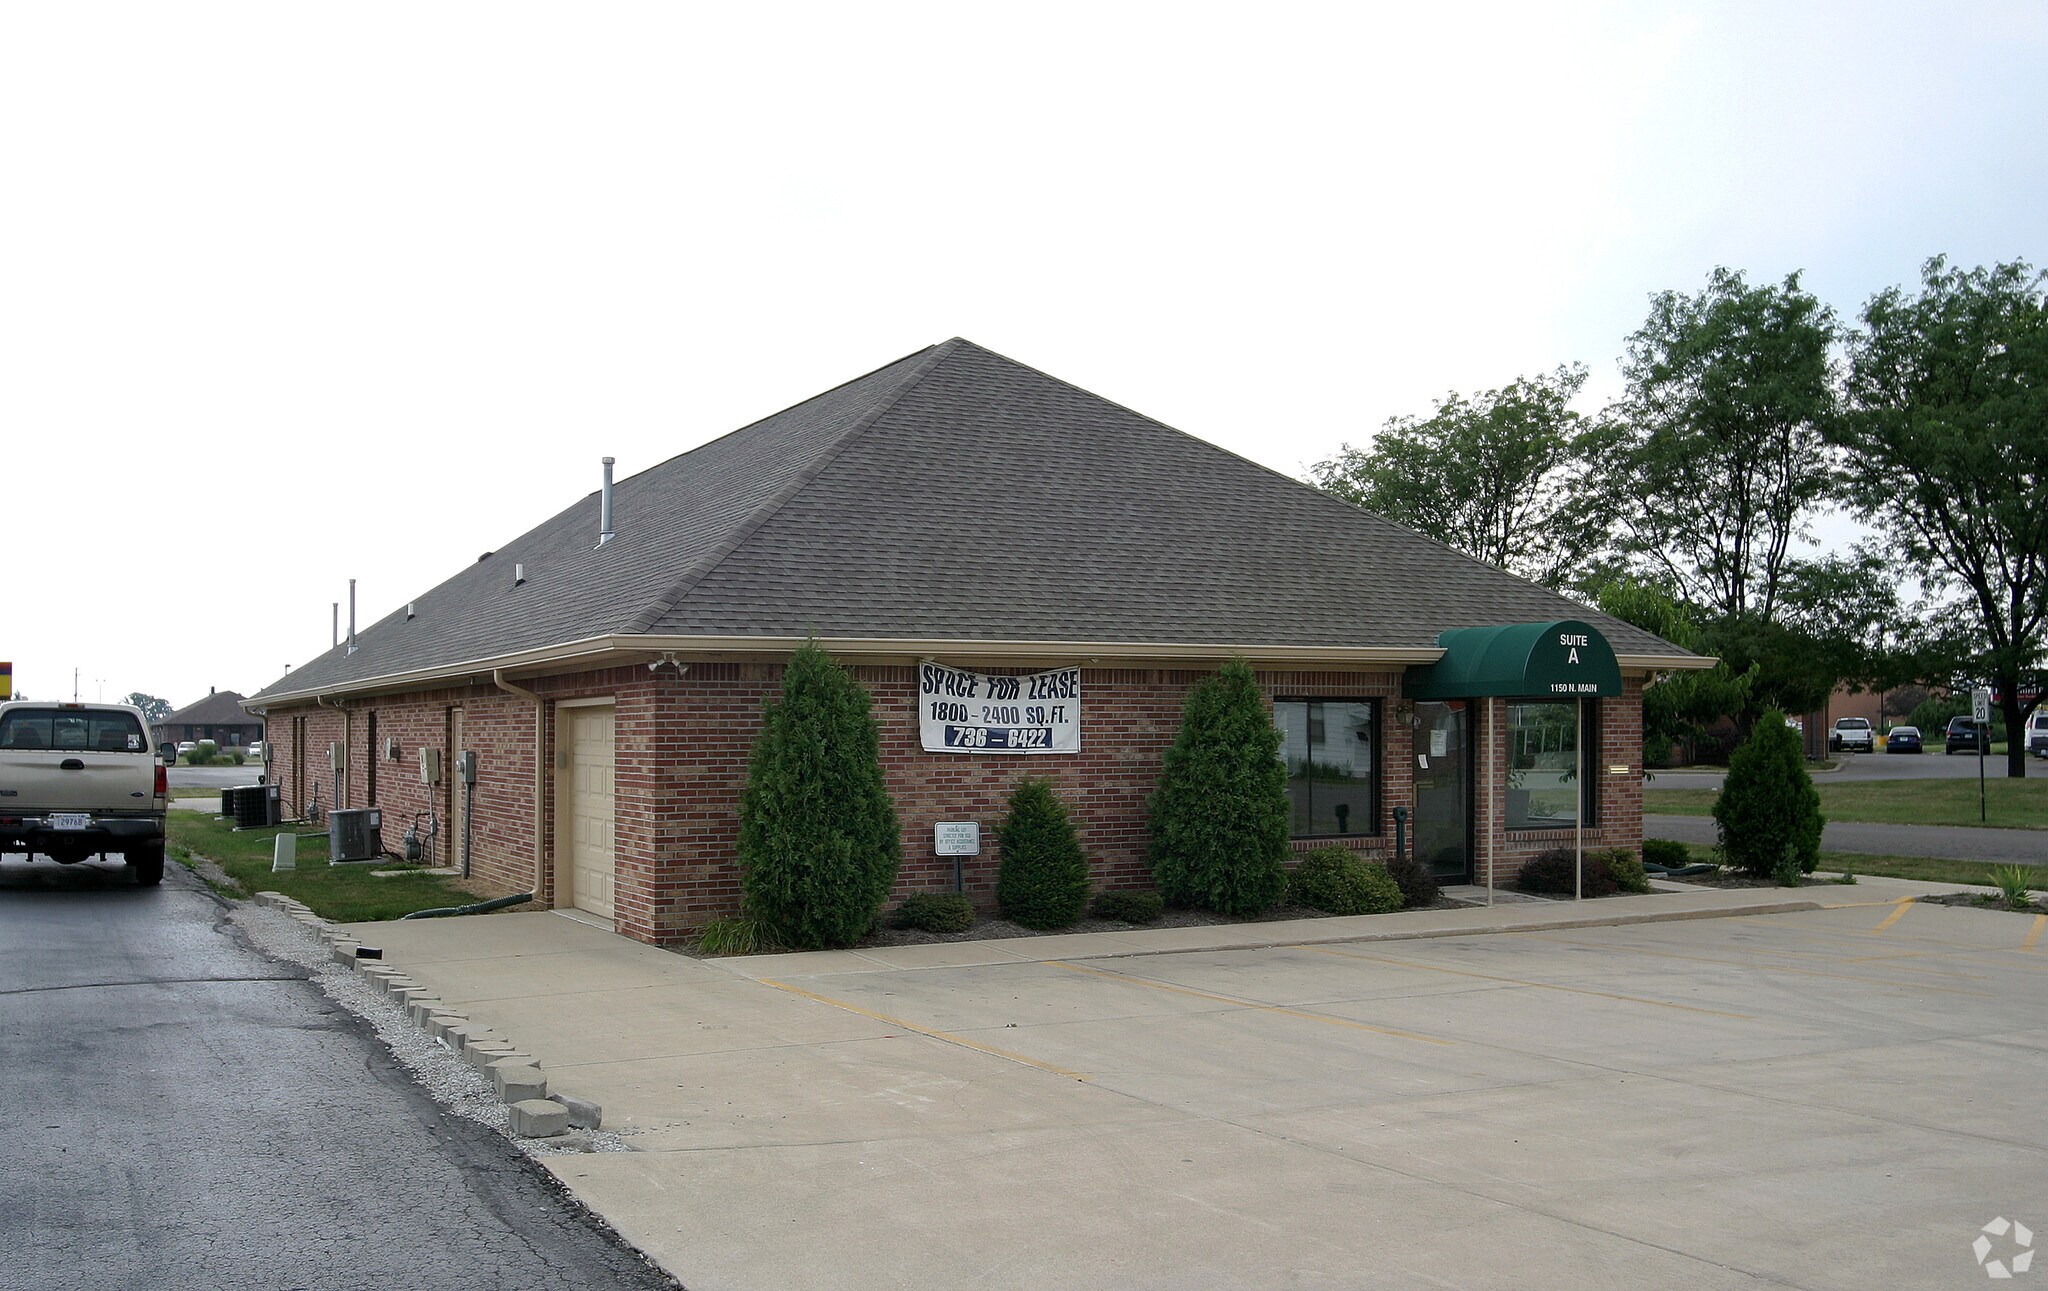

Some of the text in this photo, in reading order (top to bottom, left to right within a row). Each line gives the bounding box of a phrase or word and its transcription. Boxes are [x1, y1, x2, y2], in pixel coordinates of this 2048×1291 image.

[1559, 633, 1588, 647] SUITE
[1567, 647, 1580, 664] A
[922, 665, 1078, 700] SPACE FOR LEASE
[1550, 683, 1598, 693] 1150 N. MAIN
[1975, 707, 1986, 720] 20
